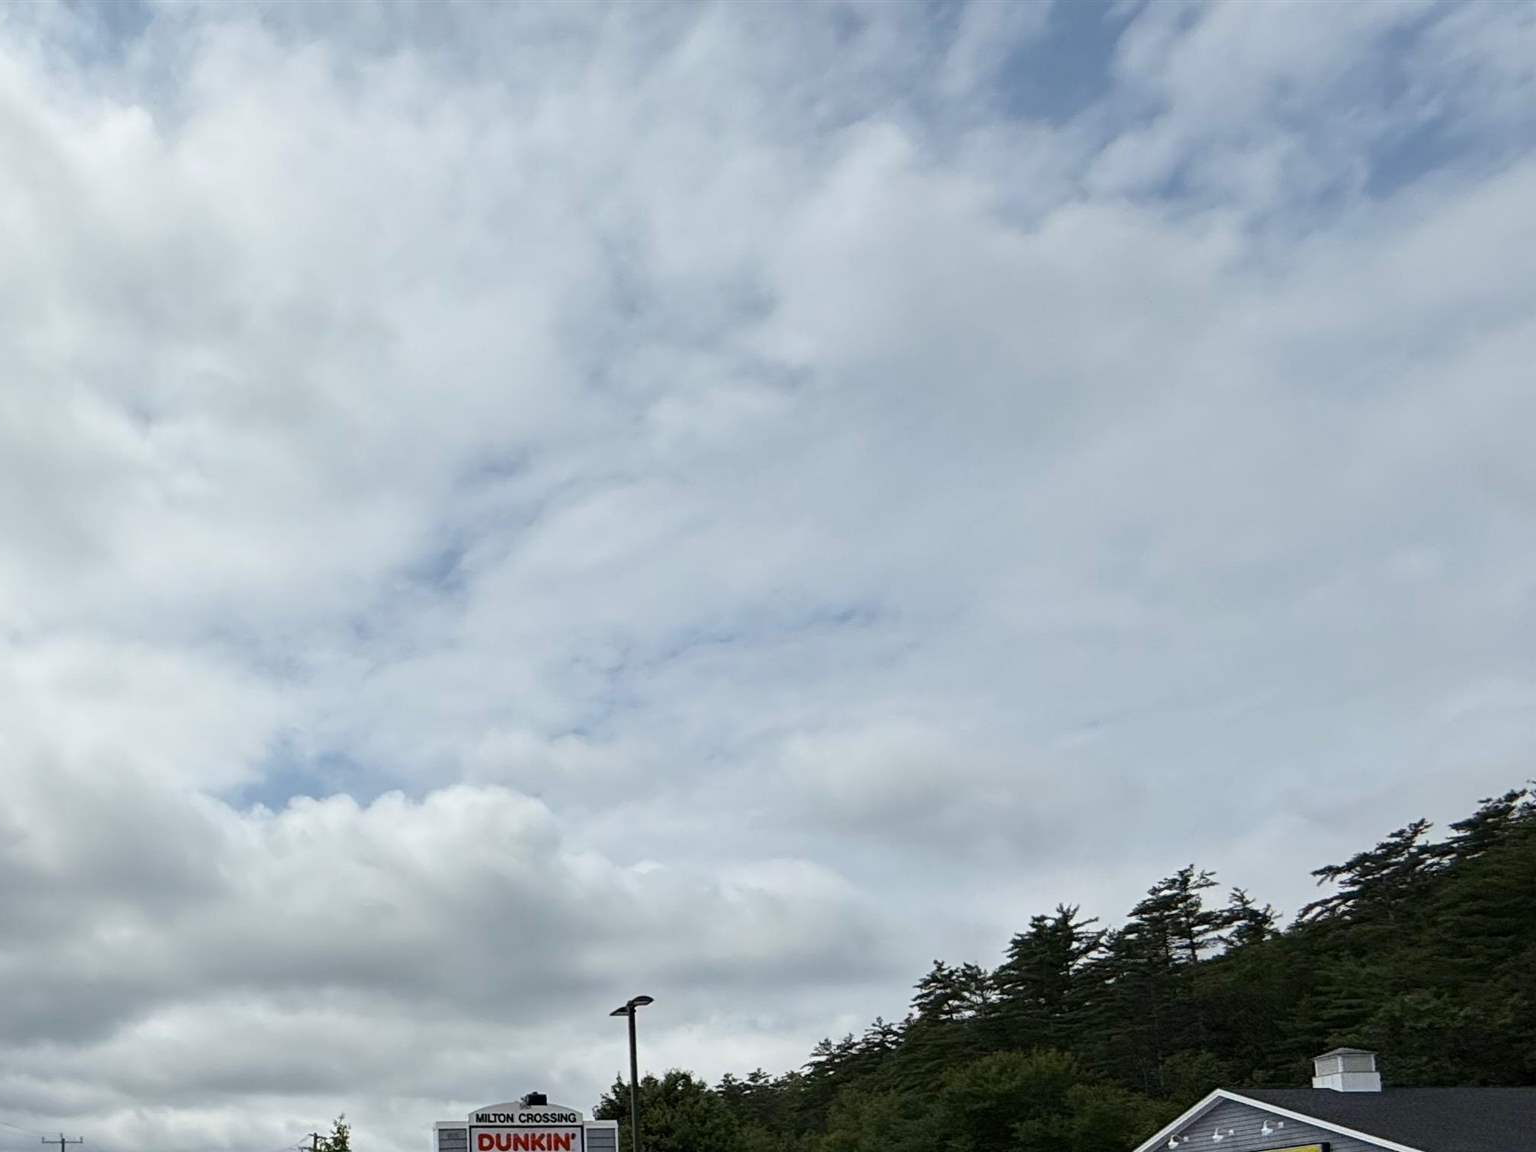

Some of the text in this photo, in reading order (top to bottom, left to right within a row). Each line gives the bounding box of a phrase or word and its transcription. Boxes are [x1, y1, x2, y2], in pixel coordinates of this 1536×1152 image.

[476, 1113, 577, 1123] MILTON CROSSING
[478, 1132, 576, 1152] DUNKIN'
